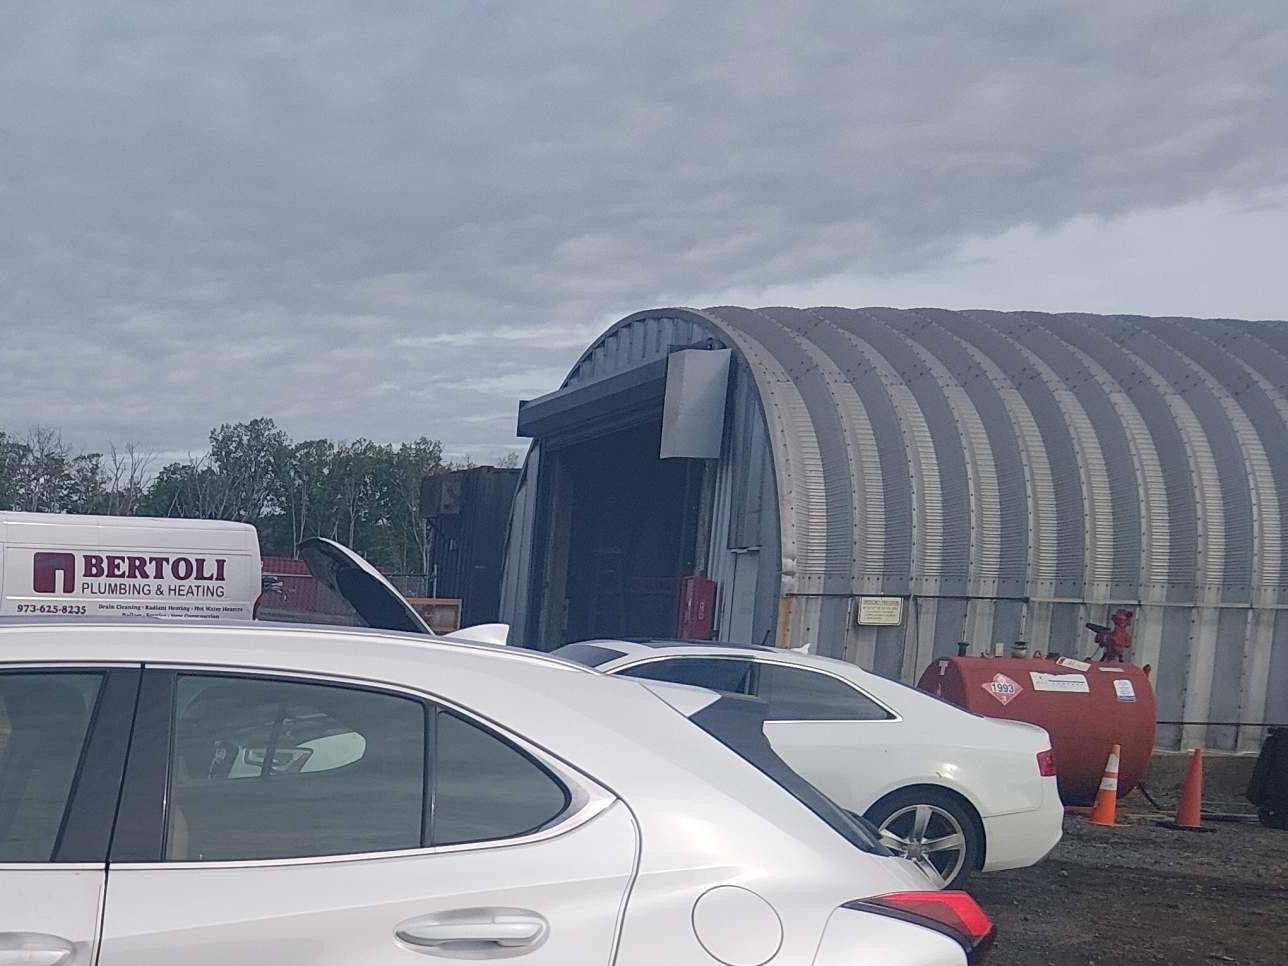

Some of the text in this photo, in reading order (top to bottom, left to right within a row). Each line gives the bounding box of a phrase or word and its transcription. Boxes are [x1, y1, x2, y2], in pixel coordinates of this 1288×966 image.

[82, 554, 227, 582] BERTOLI
[82, 582, 225, 598] PLUMBING & HEATING
[17, 604, 87, 615] 973-625-8235
[991, 683, 1014, 695] 1993
